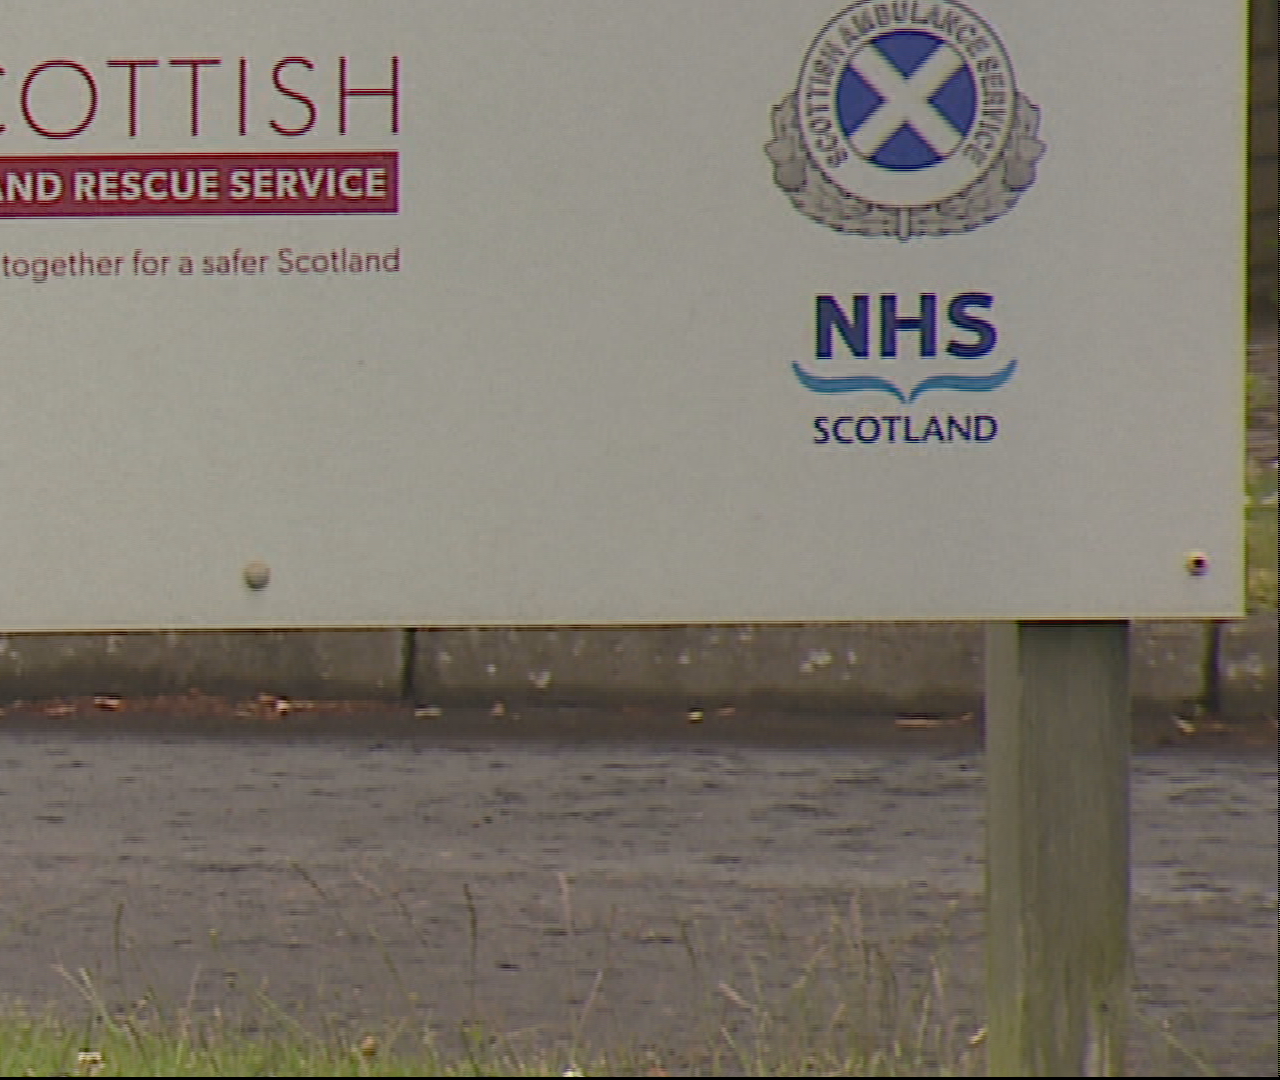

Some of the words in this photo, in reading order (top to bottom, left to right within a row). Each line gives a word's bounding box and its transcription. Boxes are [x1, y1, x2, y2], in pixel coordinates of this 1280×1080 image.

[804, 41, 847, 167] SCOTTISH
[838, 0, 990, 58] AMBULANCE
[74, 170, 219, 202] RESCUE
[230, 168, 387, 200] SERVICE
[1, 248, 124, 283] together
[131, 248, 171, 277] for
[178, 257, 194, 276] a
[201, 248, 268, 276] safer
[277, 246, 401, 276] Scotland
[814, 292, 999, 361] NHS
[813, 414, 999, 445] SCOTLAND
